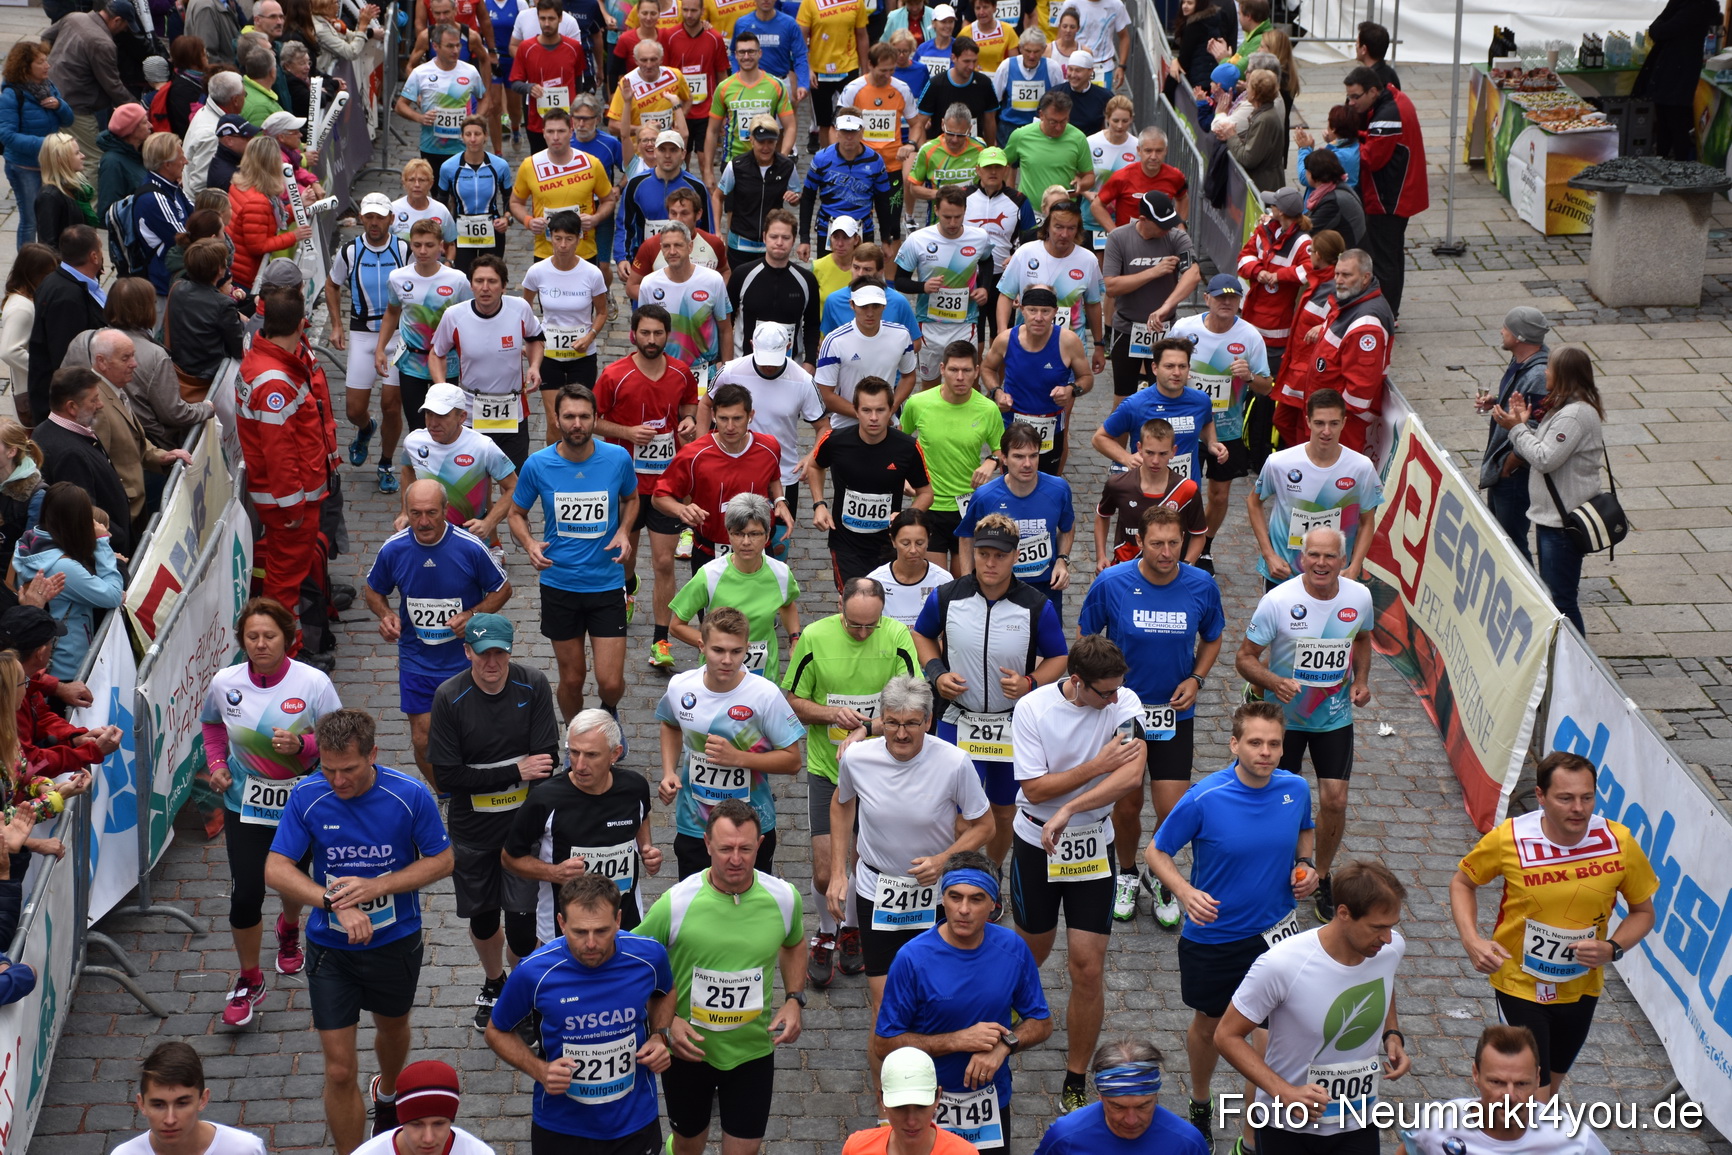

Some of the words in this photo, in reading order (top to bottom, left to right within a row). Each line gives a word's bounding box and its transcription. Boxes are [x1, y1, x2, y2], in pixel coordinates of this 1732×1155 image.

[718, 7, 736, 16] MAX
[820, 10, 839, 19] MAX
[840, 4, 860, 13] BÖGL
[995, 6, 1019, 18] 2173
[546, 94, 560, 107] 15
[1019, 89, 1038, 100] 521
[637, 98, 657, 109] MAX
[730, 100, 772, 110] BOCK
[437, 115, 464, 127] 2815
[869, 116, 890, 130] 346
[934, 168, 977, 180] BOCK
[539, 180, 564, 192] MAX
[566, 174, 594, 188] BÖGL
[288, 183, 300, 207] BMW
[465, 223, 487, 236] 166
[937, 296, 961, 310] 238
[938, 310, 957, 319] Florian
[553, 335, 578, 349] 125
[1136, 331, 1166, 346] 2607
[482, 404, 510, 418] 514
[639, 442, 673, 459] 2246
[560, 503, 603, 520] 2276
[847, 501, 887, 519] 3046
[567, 524, 598, 532] Bernhard
[1018, 542, 1048, 563] 550
[1013, 563, 1044, 573] Christoph
[1133, 610, 1187, 624] HUBER
[1340, 610, 1356, 619] Hervis
[424, 631, 450, 639] Werner
[1301, 651, 1346, 669] 2048
[1418, 582, 1494, 754] PFLASTERSTEINE
[1300, 672, 1341, 680] Hans-Dieter
[284, 701, 304, 710] Hervis
[679, 711, 694, 719] PARTL
[969, 725, 1004, 741] 287
[969, 745, 1003, 754] Christian
[694, 764, 745, 787] 2778
[249, 785, 291, 807] 200
[491, 796, 516, 805] Enrico
[705, 789, 732, 799] Paulus
[1071, 829, 1098, 838] Neumarkt
[327, 845, 393, 860] SYSCAD
[596, 849, 626, 858] Neumarkt
[1061, 837, 1097, 861] 350
[1060, 864, 1098, 875] Alexander
[1523, 869, 1568, 887] MAX
[1576, 860, 1625, 879] BÖGL
[879, 878, 900, 888] PARTL
[881, 888, 933, 910] 2419
[886, 912, 922, 924] Bernhard
[1527, 924, 1550, 937] PARTL
[1551, 931, 1586, 940] Neumarkt
[1538, 962, 1576, 975] Andreas
[694, 973, 717, 984] PARTL
[718, 976, 752, 985] Neumarkt
[705, 985, 750, 1009] 257
[565, 1008, 636, 1030] SYSCAD
[709, 1013, 743, 1024] Werner
[565, 1048, 590, 1057] PARTL
[591, 1044, 627, 1056] Neumarkt
[572, 1051, 631, 1081] 2213
[1309, 1068, 1335, 1078] PARTL
[1336, 1063, 1371, 1076] Neumarkt
[579, 1082, 625, 1097] Wolfgang
[936, 1098, 993, 1125] 2149
